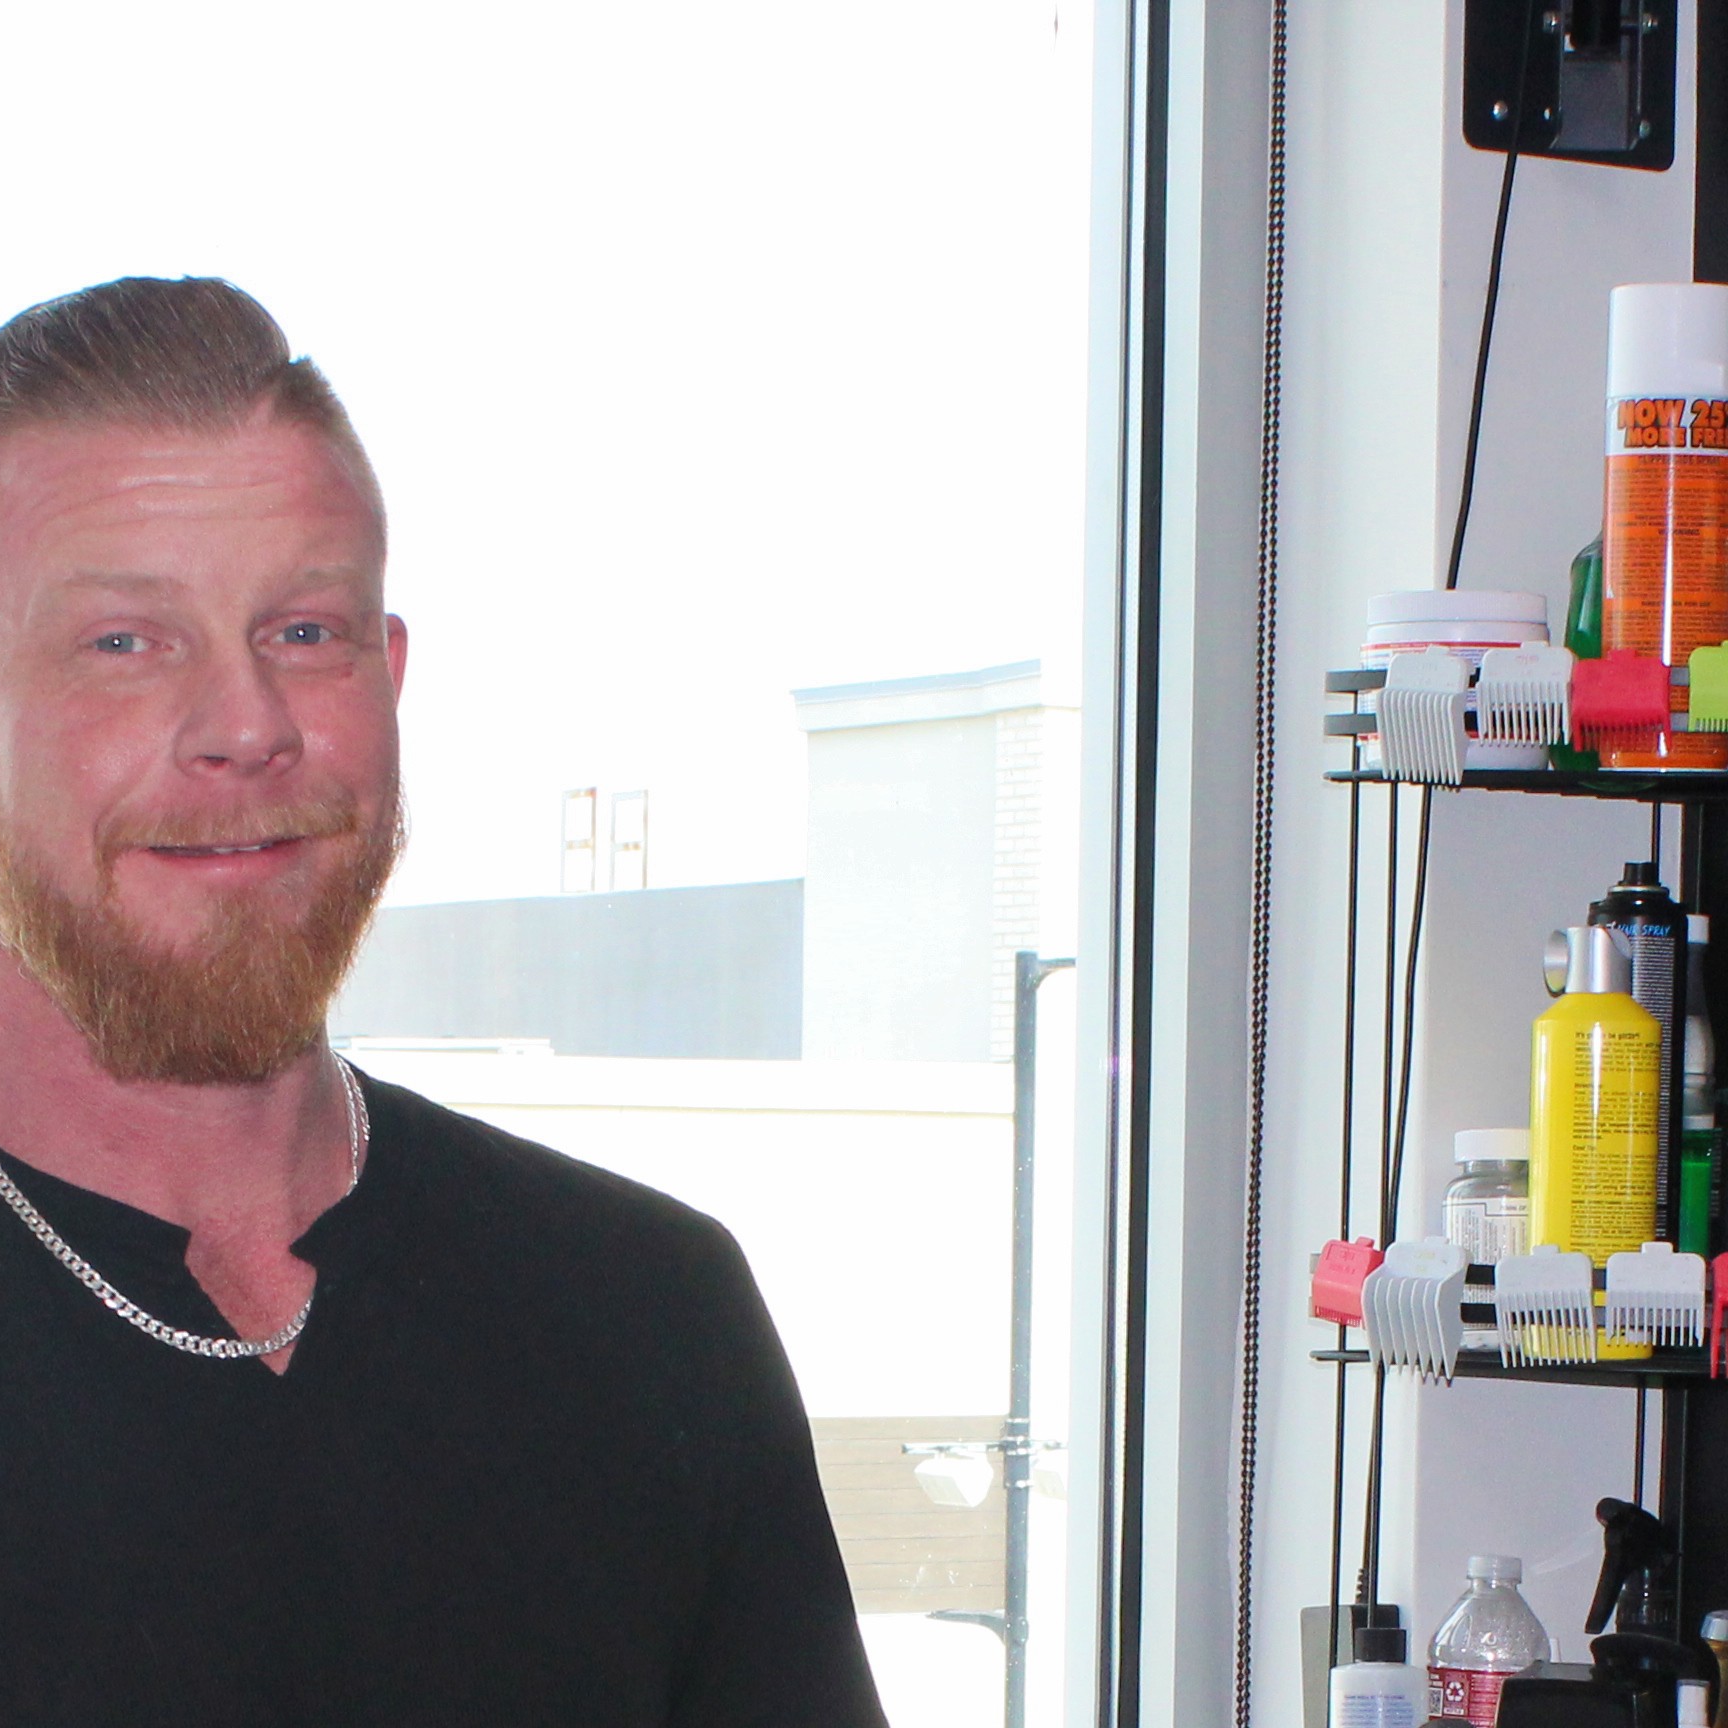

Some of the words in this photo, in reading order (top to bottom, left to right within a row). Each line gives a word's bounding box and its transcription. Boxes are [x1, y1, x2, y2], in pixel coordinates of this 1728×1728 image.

[1617, 398, 1686, 429] NOW
[1624, 426, 1687, 449] MORE
[1642, 924, 1671, 937] SPRAY
